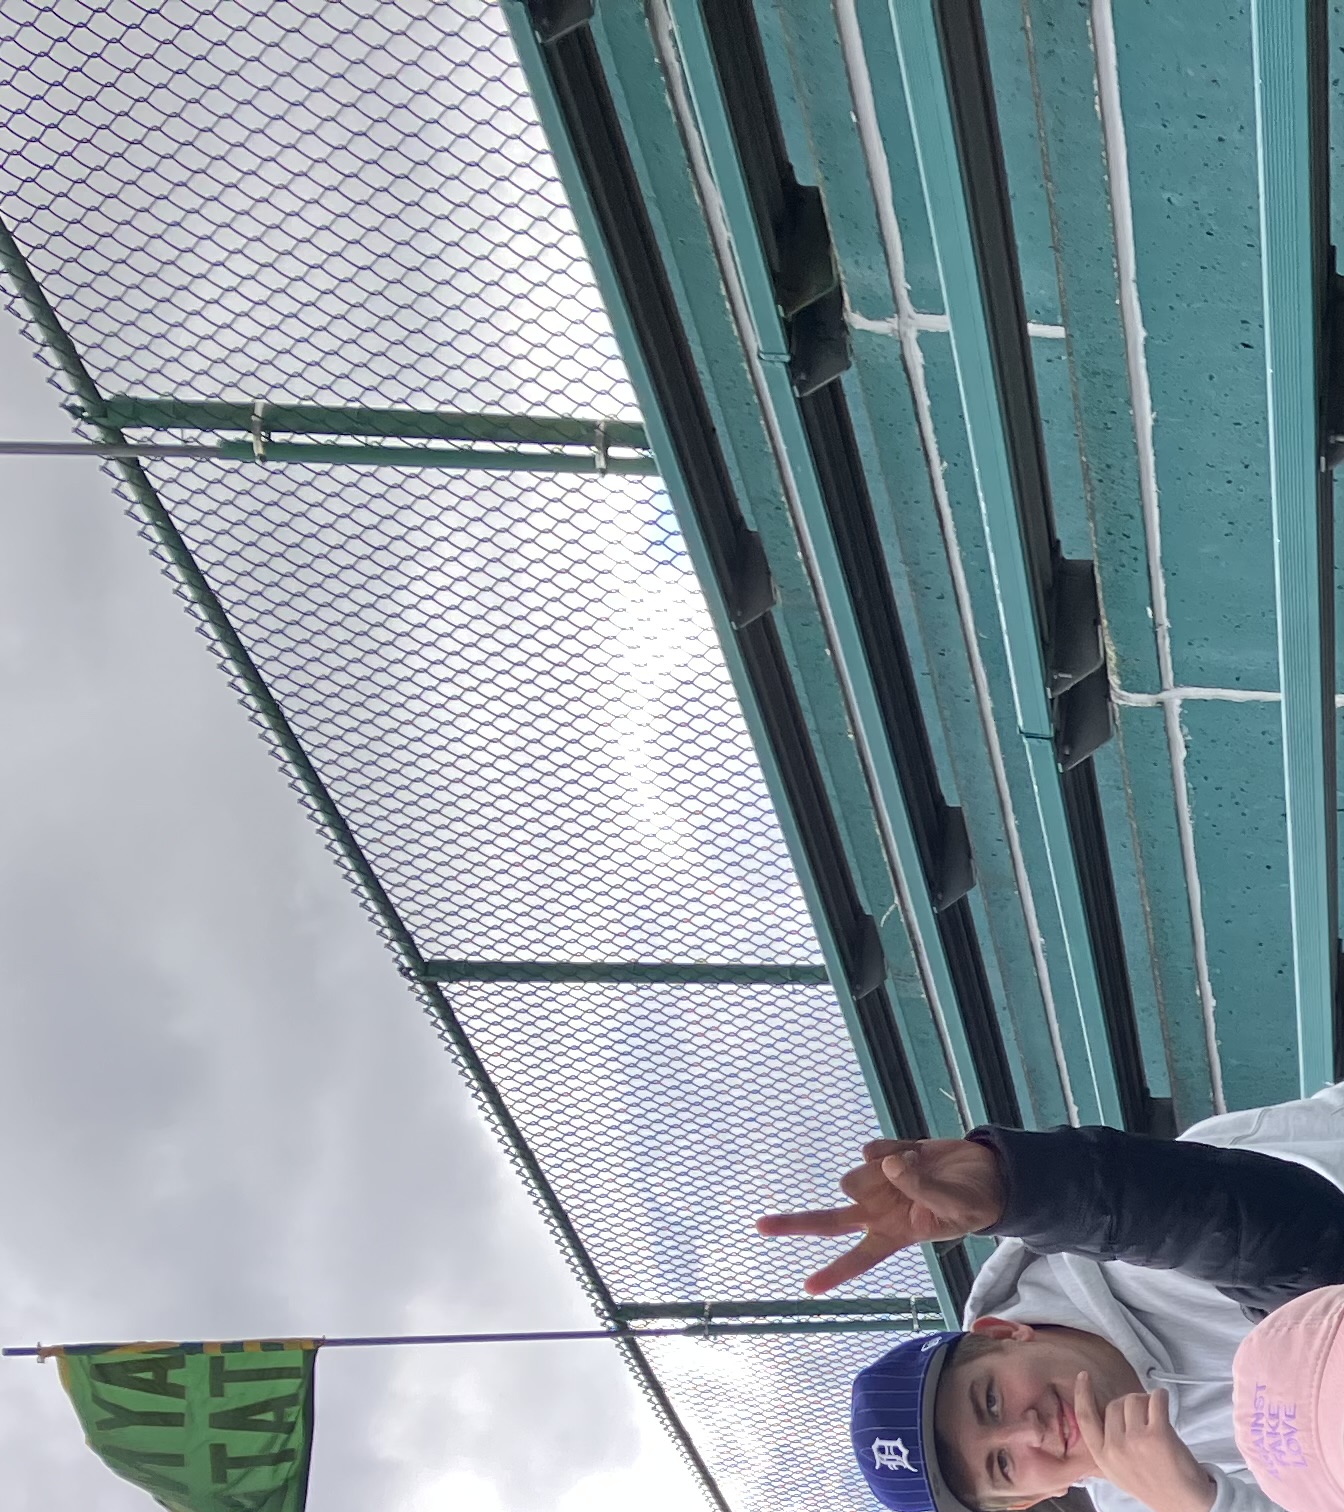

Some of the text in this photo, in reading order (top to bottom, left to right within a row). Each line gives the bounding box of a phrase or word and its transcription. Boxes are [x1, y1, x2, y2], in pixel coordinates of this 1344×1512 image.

[871, 1437, 919, 1473] D
[1250, 1382, 1283, 1480] AGAINST
[1267, 1403, 1288, 1467] FAKE
[1284, 1403, 1308, 1468] LOVE
